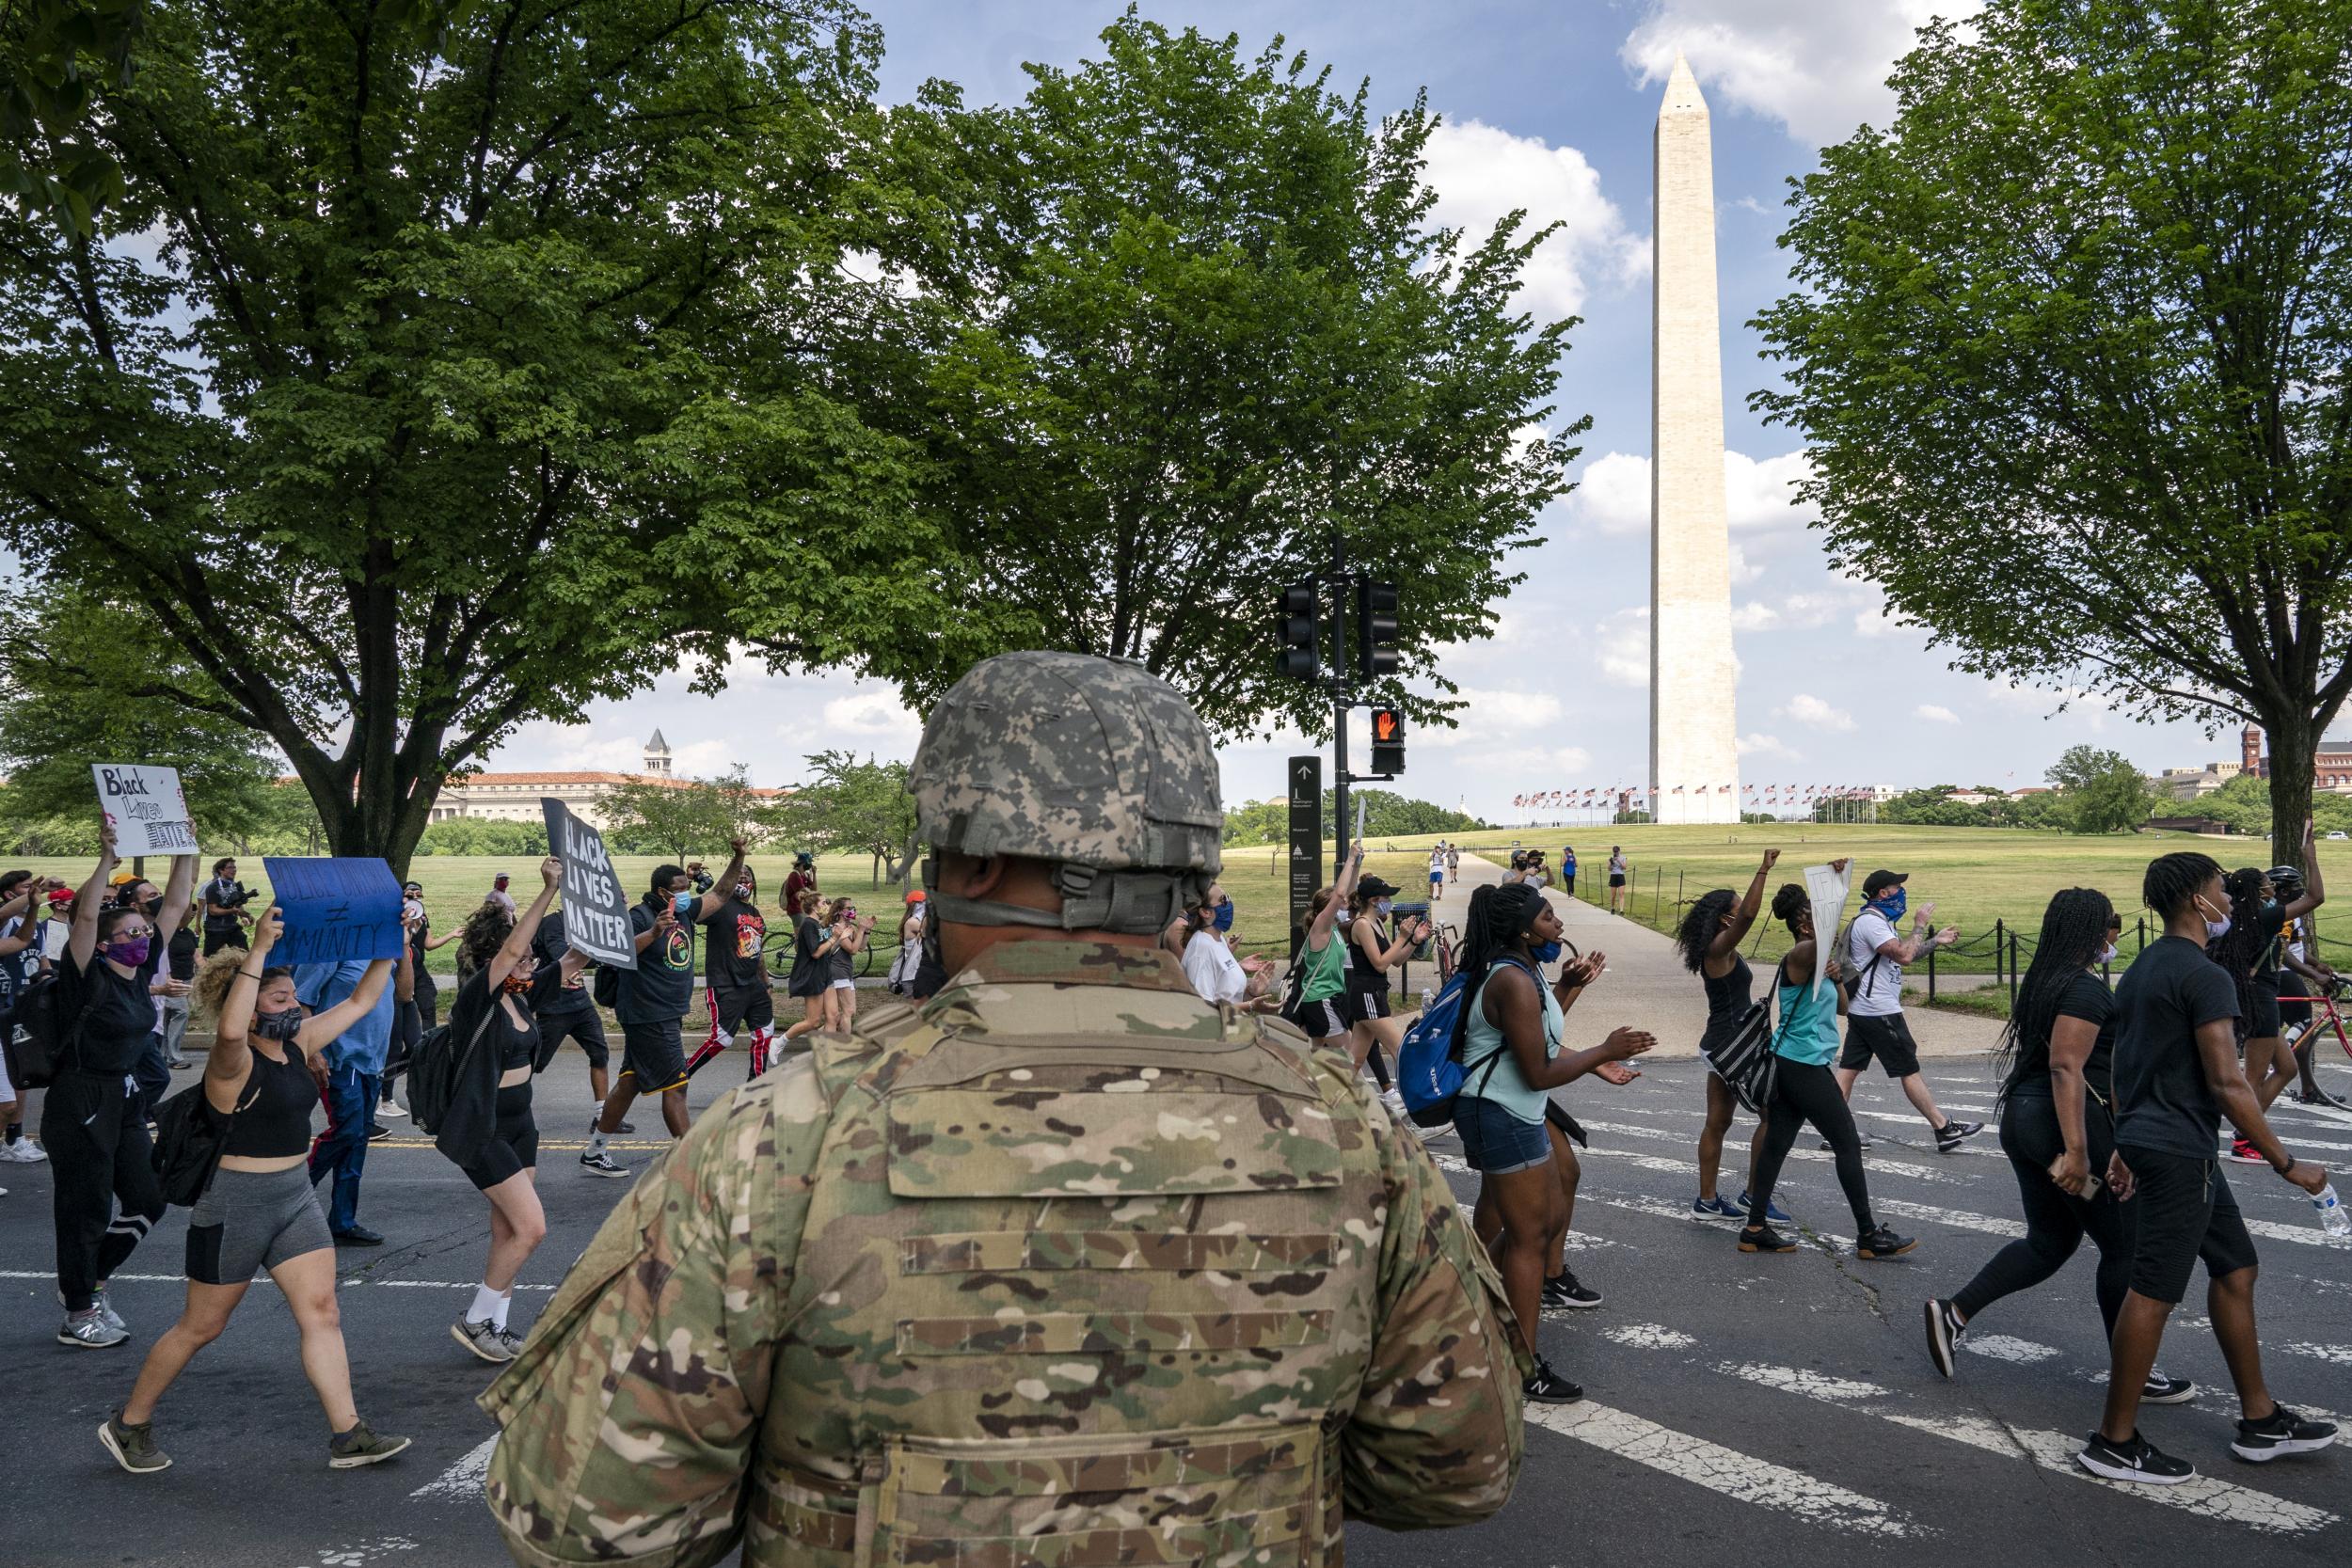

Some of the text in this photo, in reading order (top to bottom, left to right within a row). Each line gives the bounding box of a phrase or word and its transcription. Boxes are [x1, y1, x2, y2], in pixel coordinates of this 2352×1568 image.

[102, 768, 150, 796] Black
[564, 817, 610, 873] BLACK
[263, 859, 336, 901] POLICE
[566, 858, 614, 909] LIVES
[564, 897, 628, 950] MATTER
